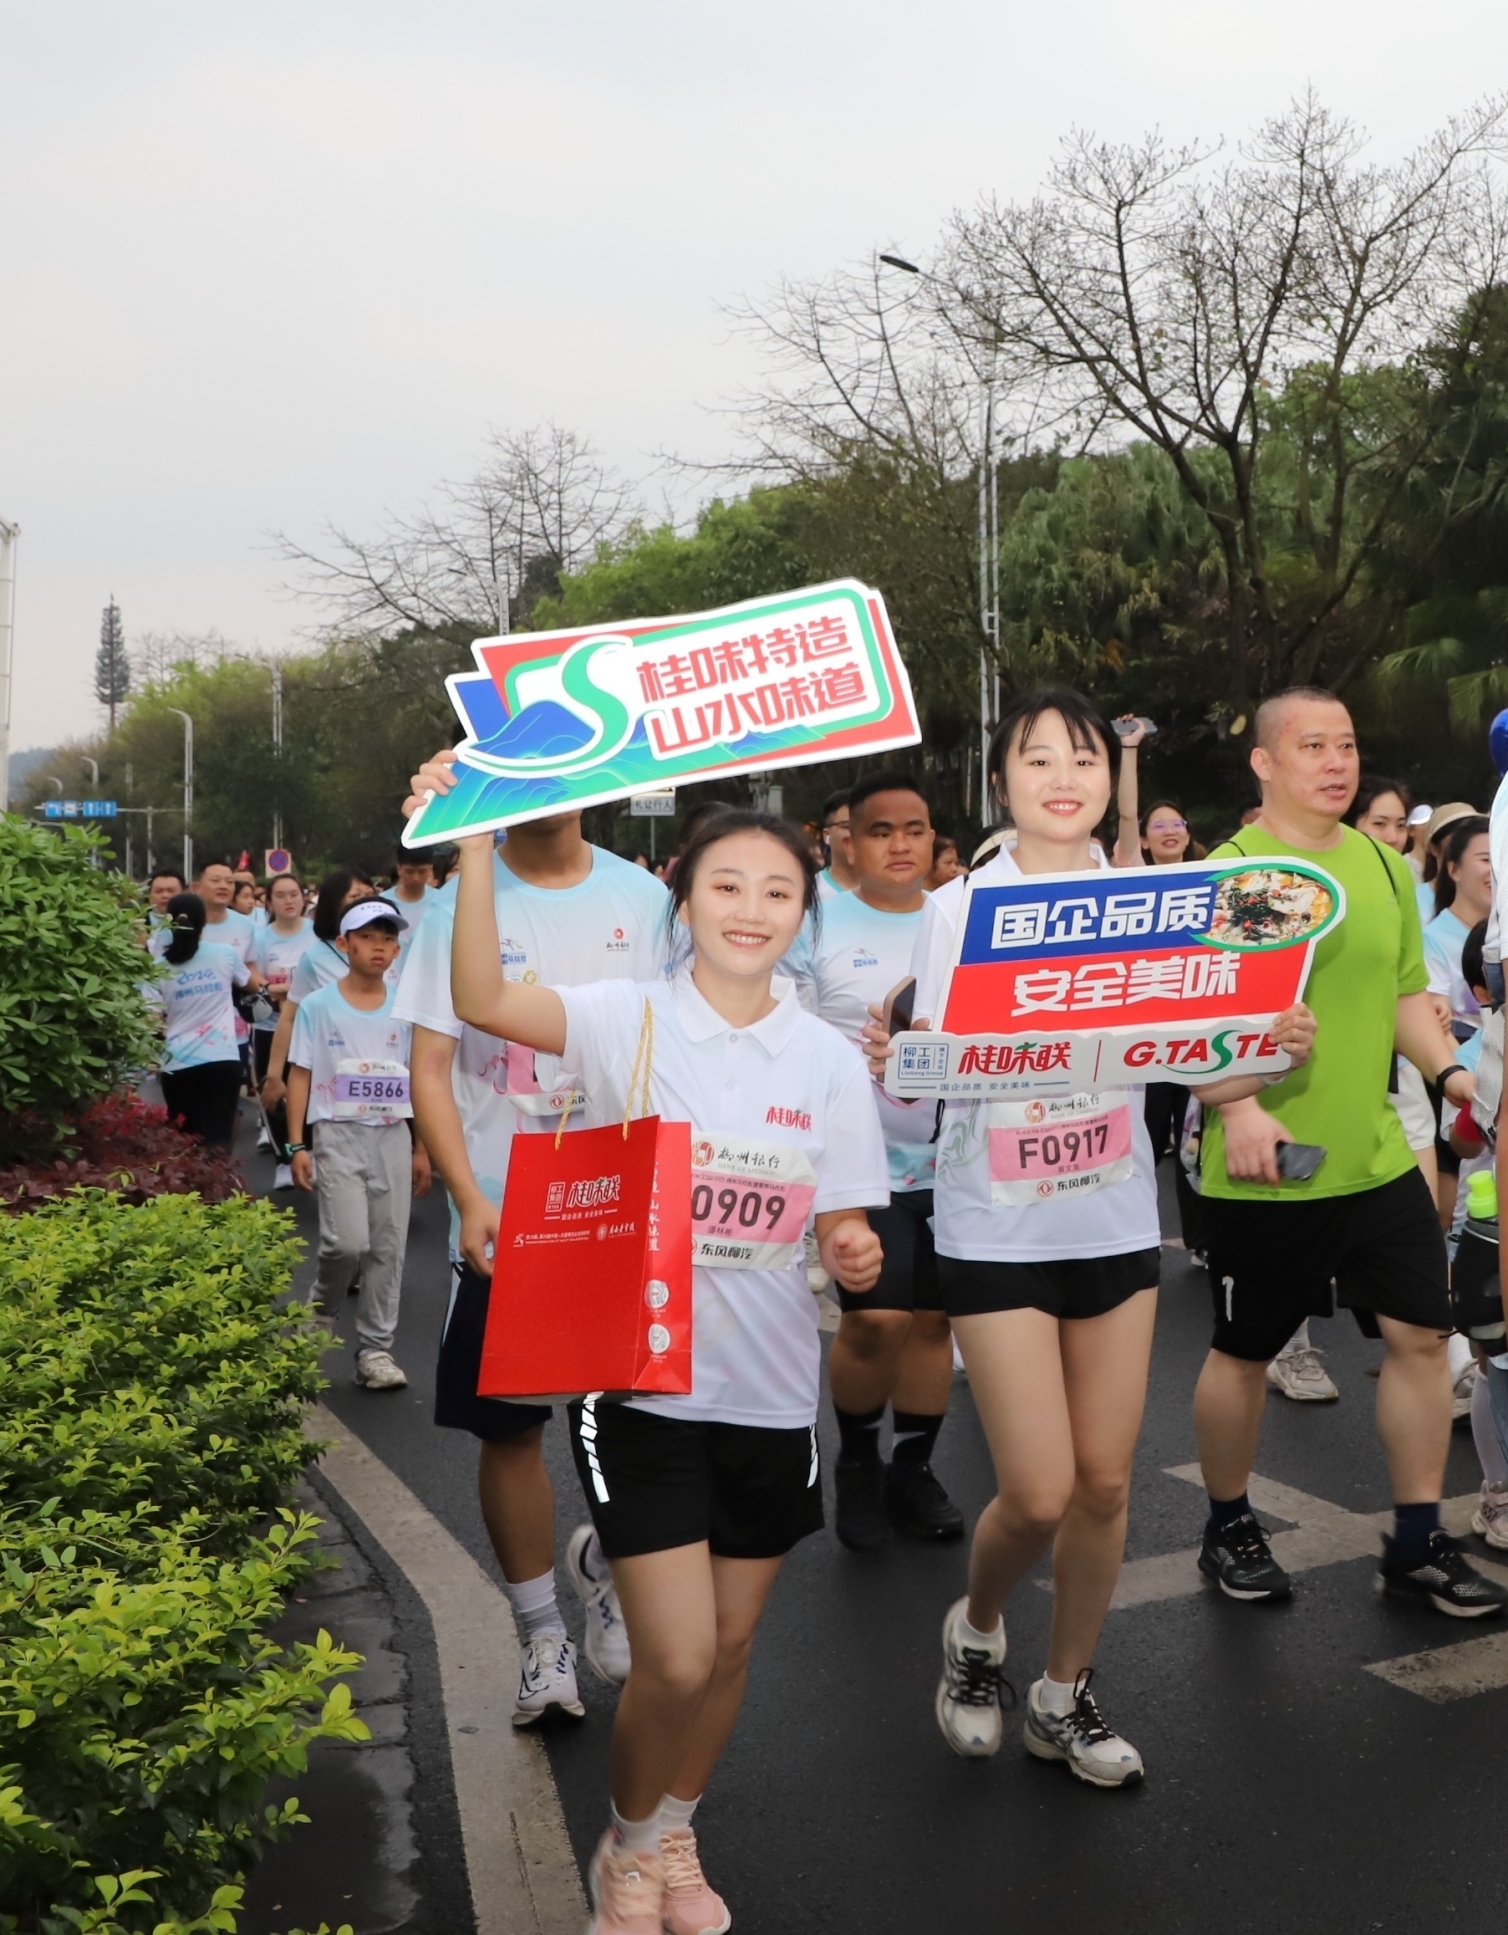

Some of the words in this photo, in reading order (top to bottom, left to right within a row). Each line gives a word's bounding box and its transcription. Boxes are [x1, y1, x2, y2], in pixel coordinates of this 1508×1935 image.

[637, 616, 852, 704] 桂味特造
[650, 661, 867, 754] 山水味道
[990, 886, 1212, 950] 国企品质
[1010, 951, 1240, 1017] 安全美味
[901, 1059, 930, 1070] 集团
[902, 1047, 931, 1058] 柳工
[958, 1041, 1072, 1075] 桂味联
[1123, 1029, 1281, 1074] G.TASTE
[348, 1081, 404, 1098] E5866
[1018, 1124, 1109, 1169] F0917
